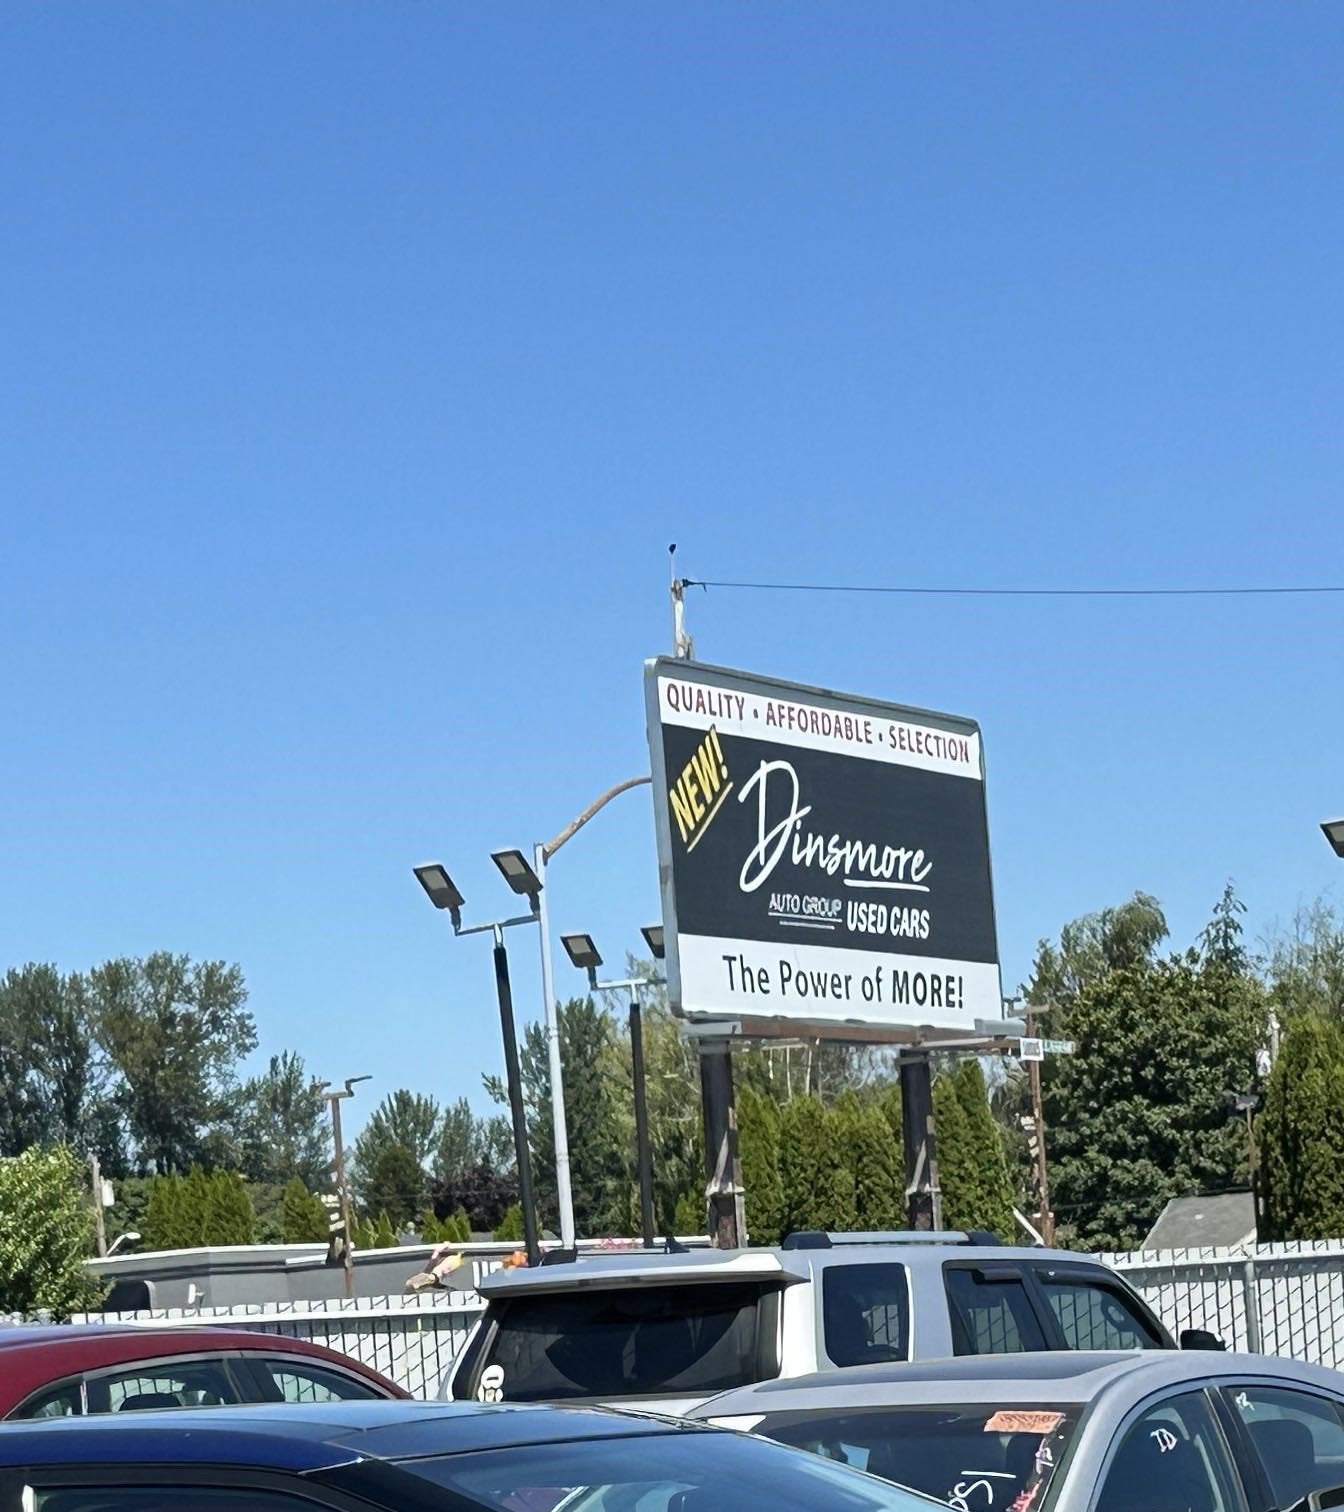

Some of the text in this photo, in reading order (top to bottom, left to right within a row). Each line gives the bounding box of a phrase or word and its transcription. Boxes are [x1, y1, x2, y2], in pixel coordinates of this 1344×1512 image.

[667, 683, 970, 763] QUALITY AFFORDABLE SELECTION
[669, 727, 729, 843] NEW!
[738, 760, 932, 892] Dinsmore
[768, 893, 842, 917] AUTO GROUP
[847, 901, 930, 939] USED CARS
[722, 954, 963, 1009] The Power of MORE!
